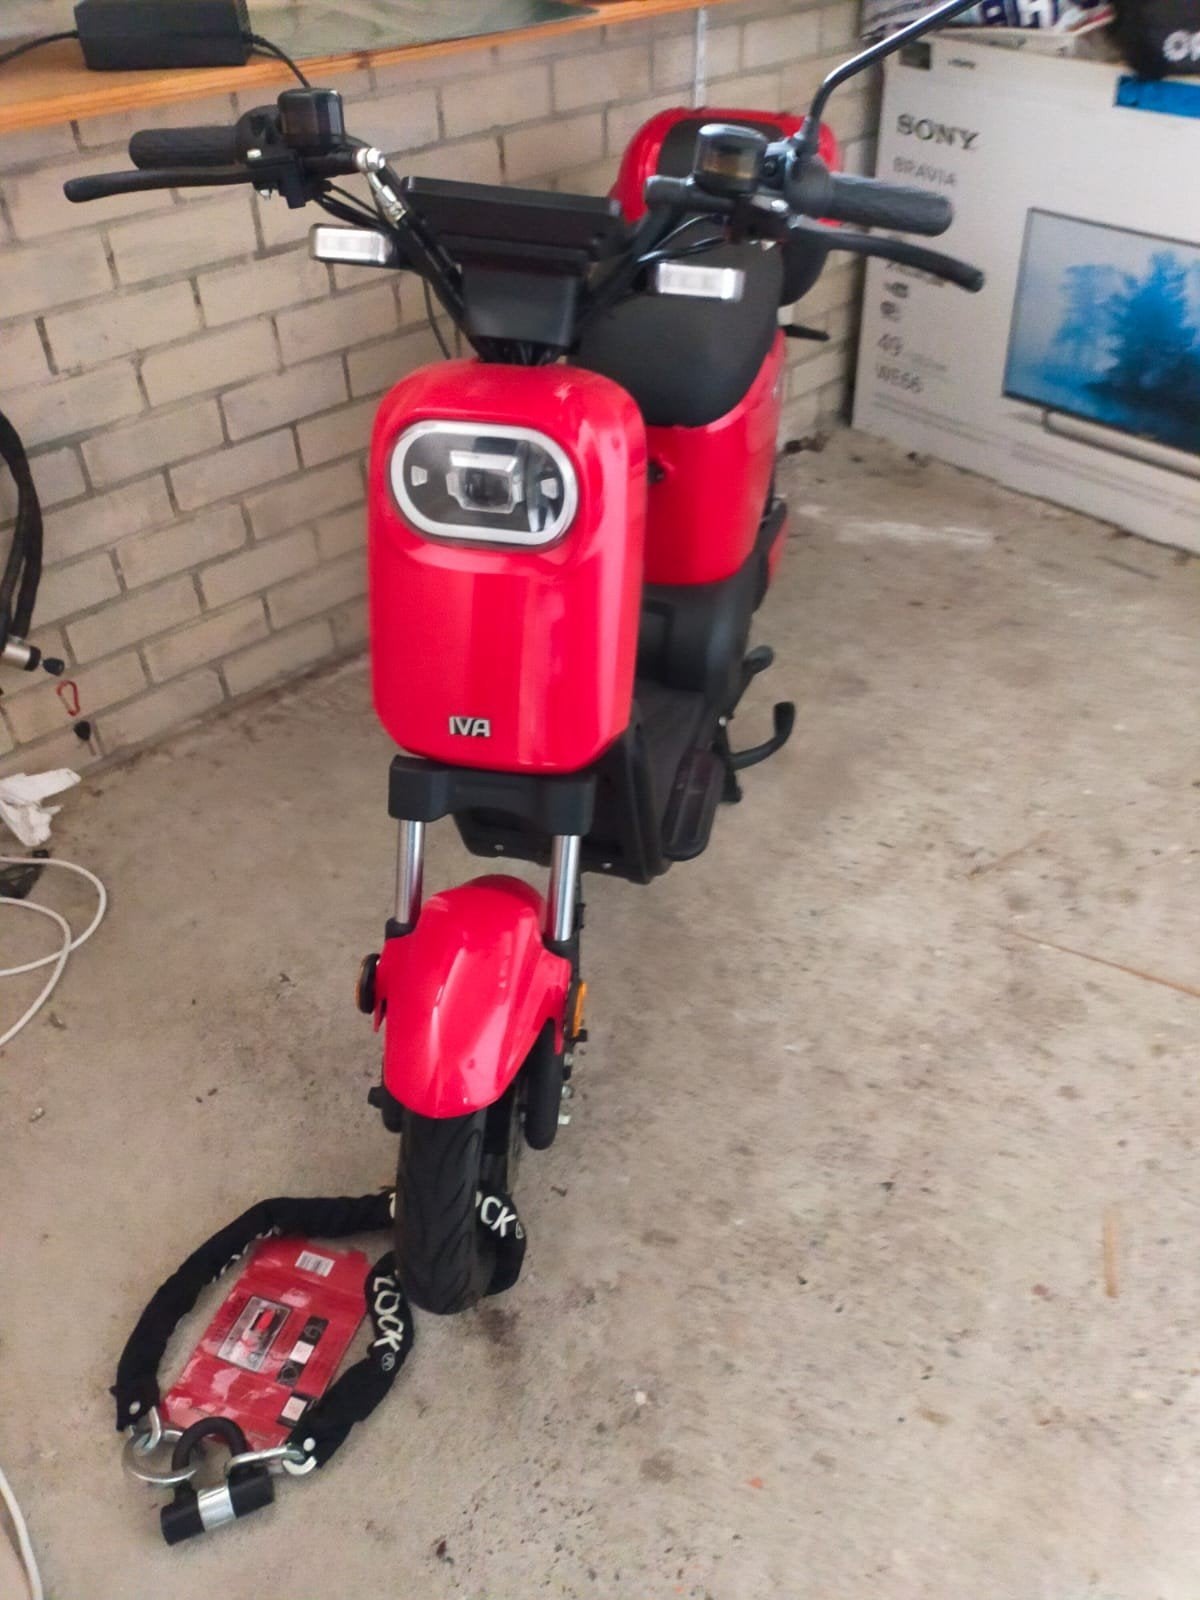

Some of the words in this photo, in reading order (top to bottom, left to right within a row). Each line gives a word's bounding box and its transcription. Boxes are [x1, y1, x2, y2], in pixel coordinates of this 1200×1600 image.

[896, 113, 979, 150] SONY
[893, 157, 957, 186] BRAVIA
[449, 716, 490, 737] IVA
[475, 1191, 517, 1238] CK
